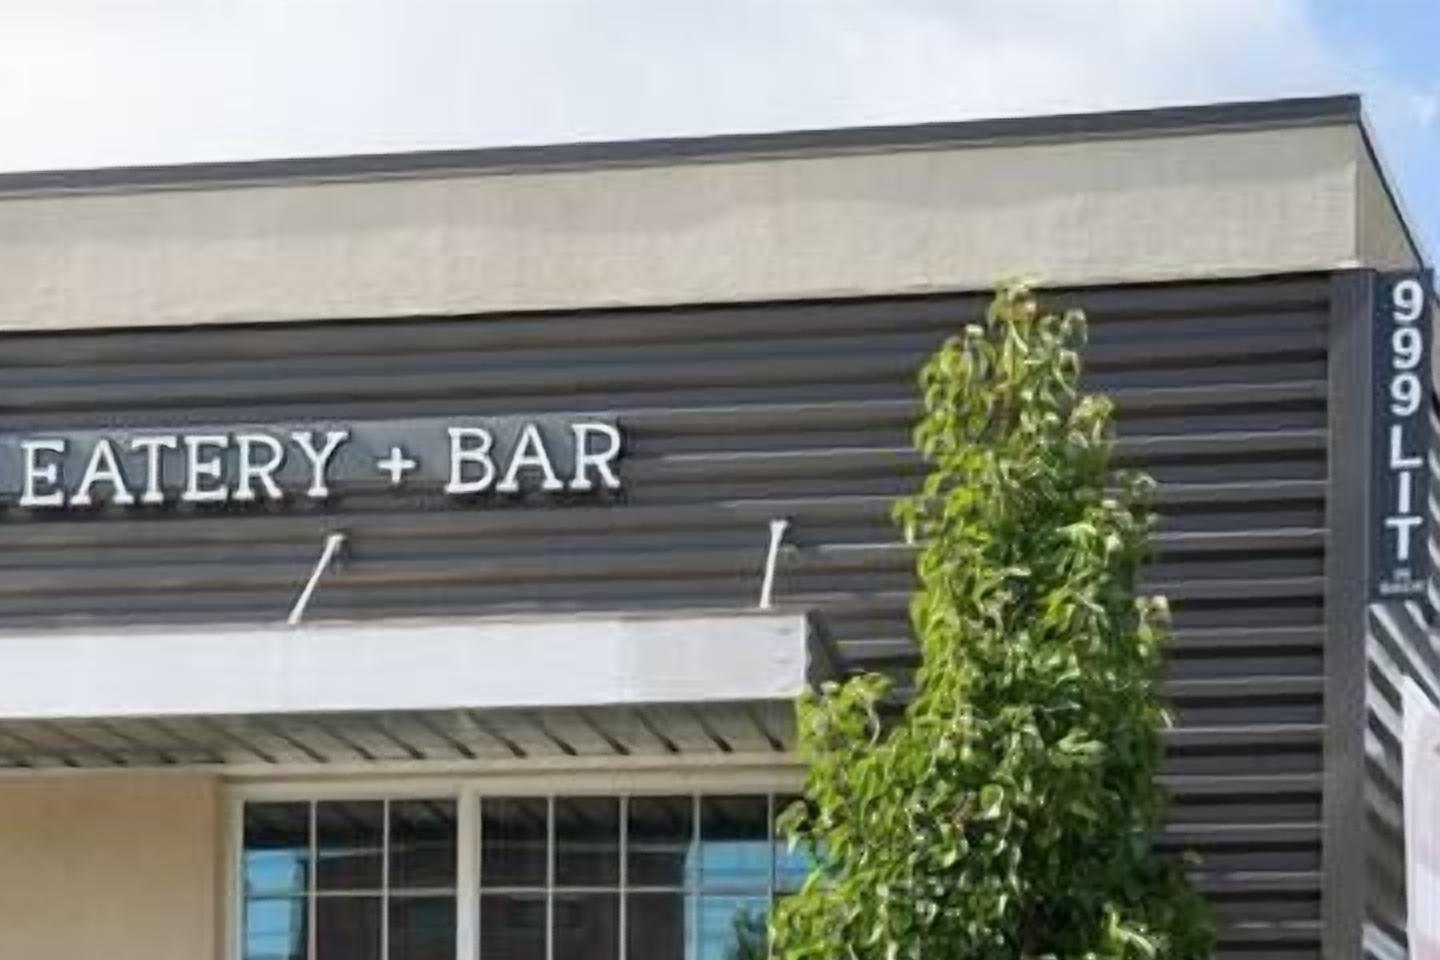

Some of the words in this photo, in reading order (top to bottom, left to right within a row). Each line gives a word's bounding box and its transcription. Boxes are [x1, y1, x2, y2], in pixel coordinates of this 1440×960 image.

[19, 430, 349, 506] EATERY
[376, 446, 417, 485] +
[445, 421, 622, 493] BAR
